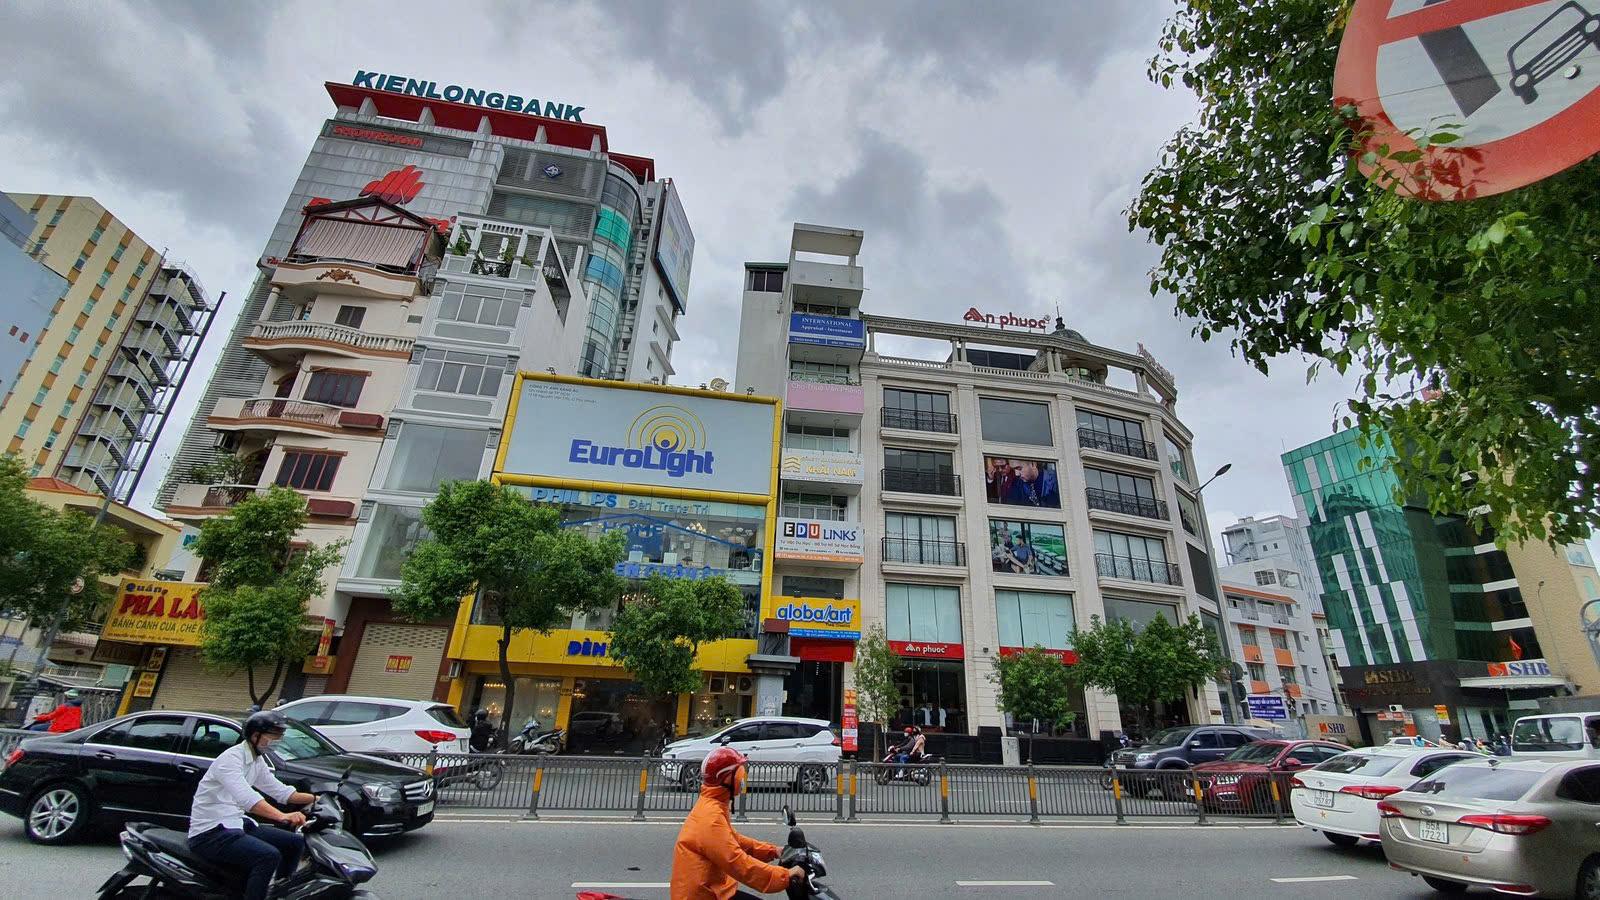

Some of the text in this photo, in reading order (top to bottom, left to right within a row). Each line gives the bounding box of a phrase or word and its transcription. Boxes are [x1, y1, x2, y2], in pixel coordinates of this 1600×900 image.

[352, 70, 585, 122] KIENLONGBANK
[802, 318, 852, 327] INTERNATIONAL
[569, 438, 714, 477] EuroLight
[784, 522, 857, 541] EDU LINKS
[1508, 662, 1552, 676] SHB
[1328, 722, 1346, 733] SHB
